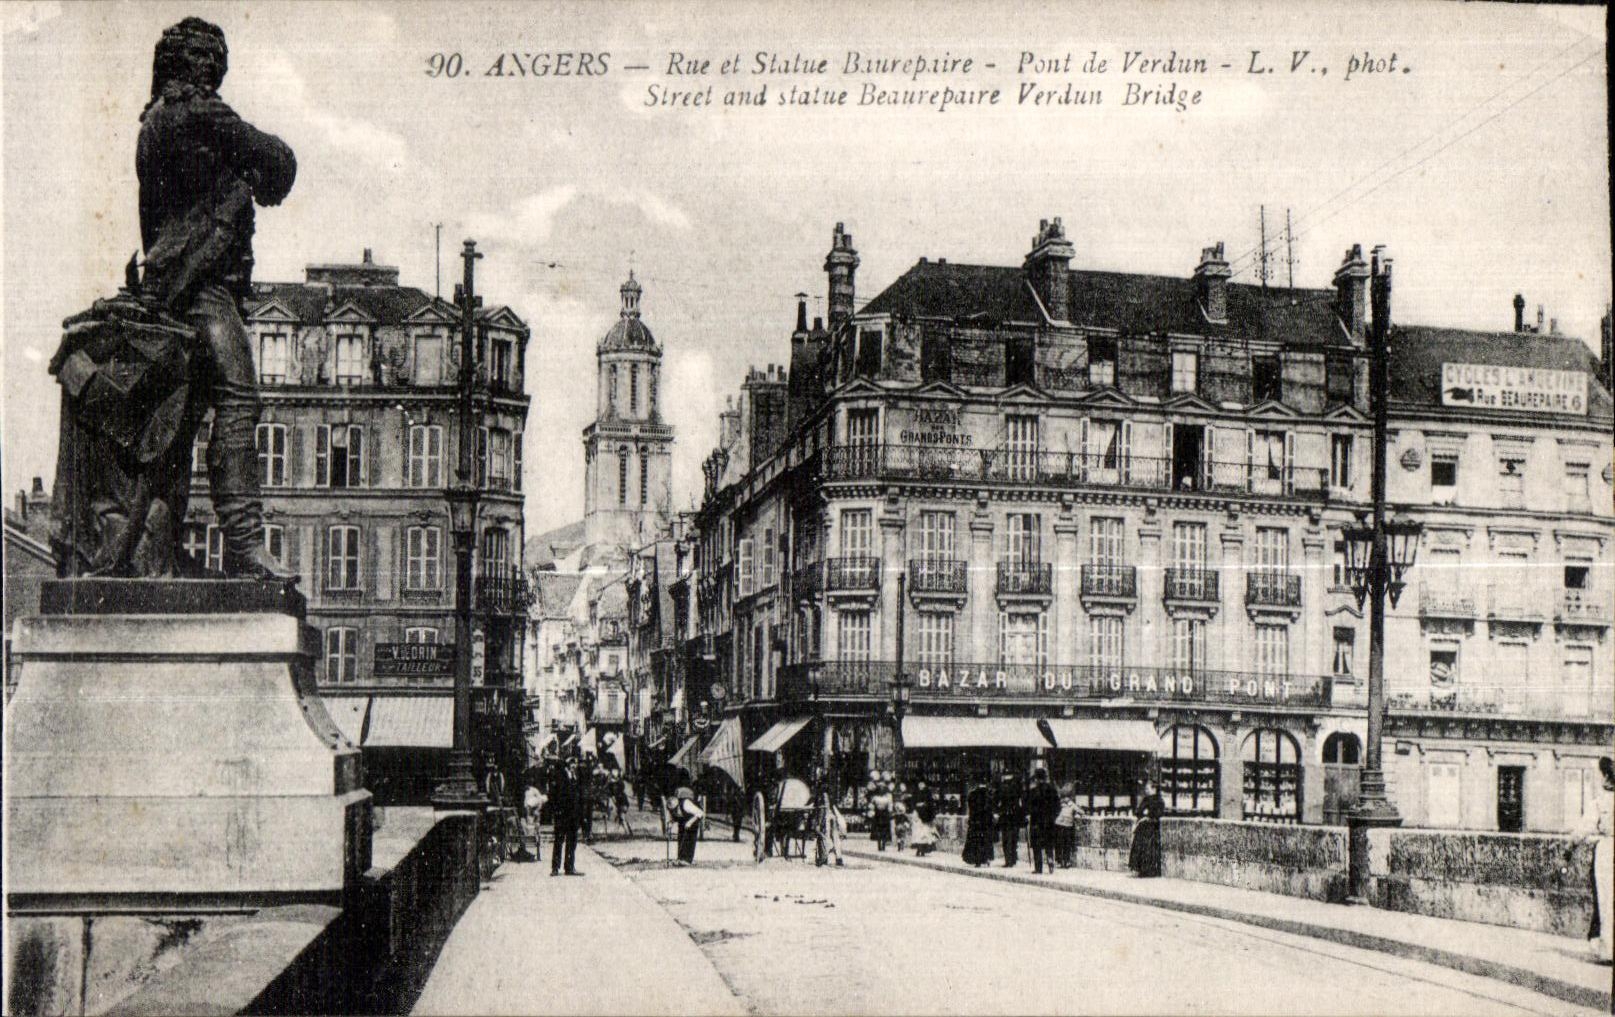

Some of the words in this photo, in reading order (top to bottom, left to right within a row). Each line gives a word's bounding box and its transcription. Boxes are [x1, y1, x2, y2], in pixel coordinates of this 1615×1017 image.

[1445, 365, 1500, 386] CYCLES
[918, 669, 1008, 688] BAZAR
[1045, 671, 1074, 690] DU
[1109, 673, 1194, 694] GRAND
[1228, 678, 1293, 698] PONT
